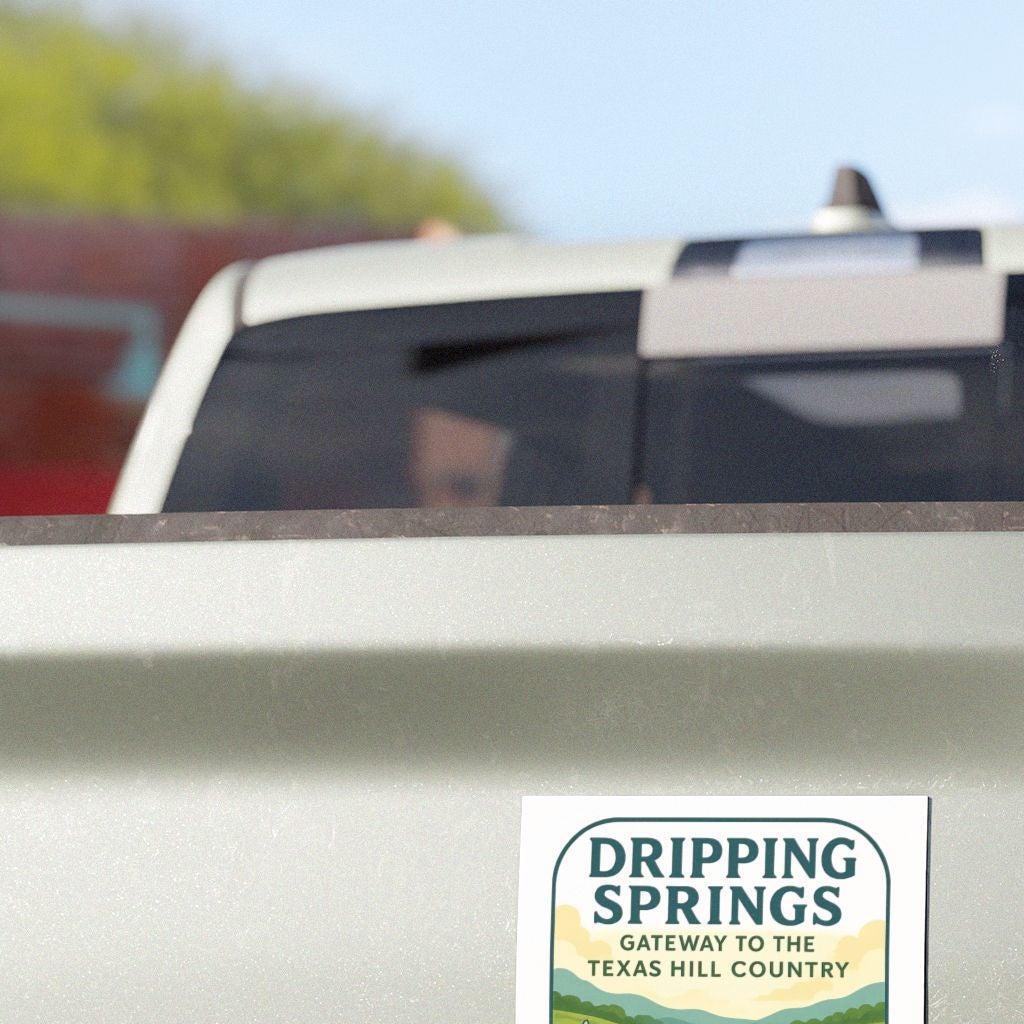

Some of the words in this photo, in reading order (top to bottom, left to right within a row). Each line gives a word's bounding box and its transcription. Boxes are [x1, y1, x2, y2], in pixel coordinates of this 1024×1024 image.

[588, 837, 857, 879] DRIPPING
[593, 884, 842, 926] SPRINGS
[619, 934, 727, 952] GATEWAY
[735, 935, 765, 952] TO
[773, 935, 815, 953] THE
[587, 959, 662, 977] TEXAS
[670, 960, 722, 978] HILL
[731, 960, 850, 978] COUNTRY
